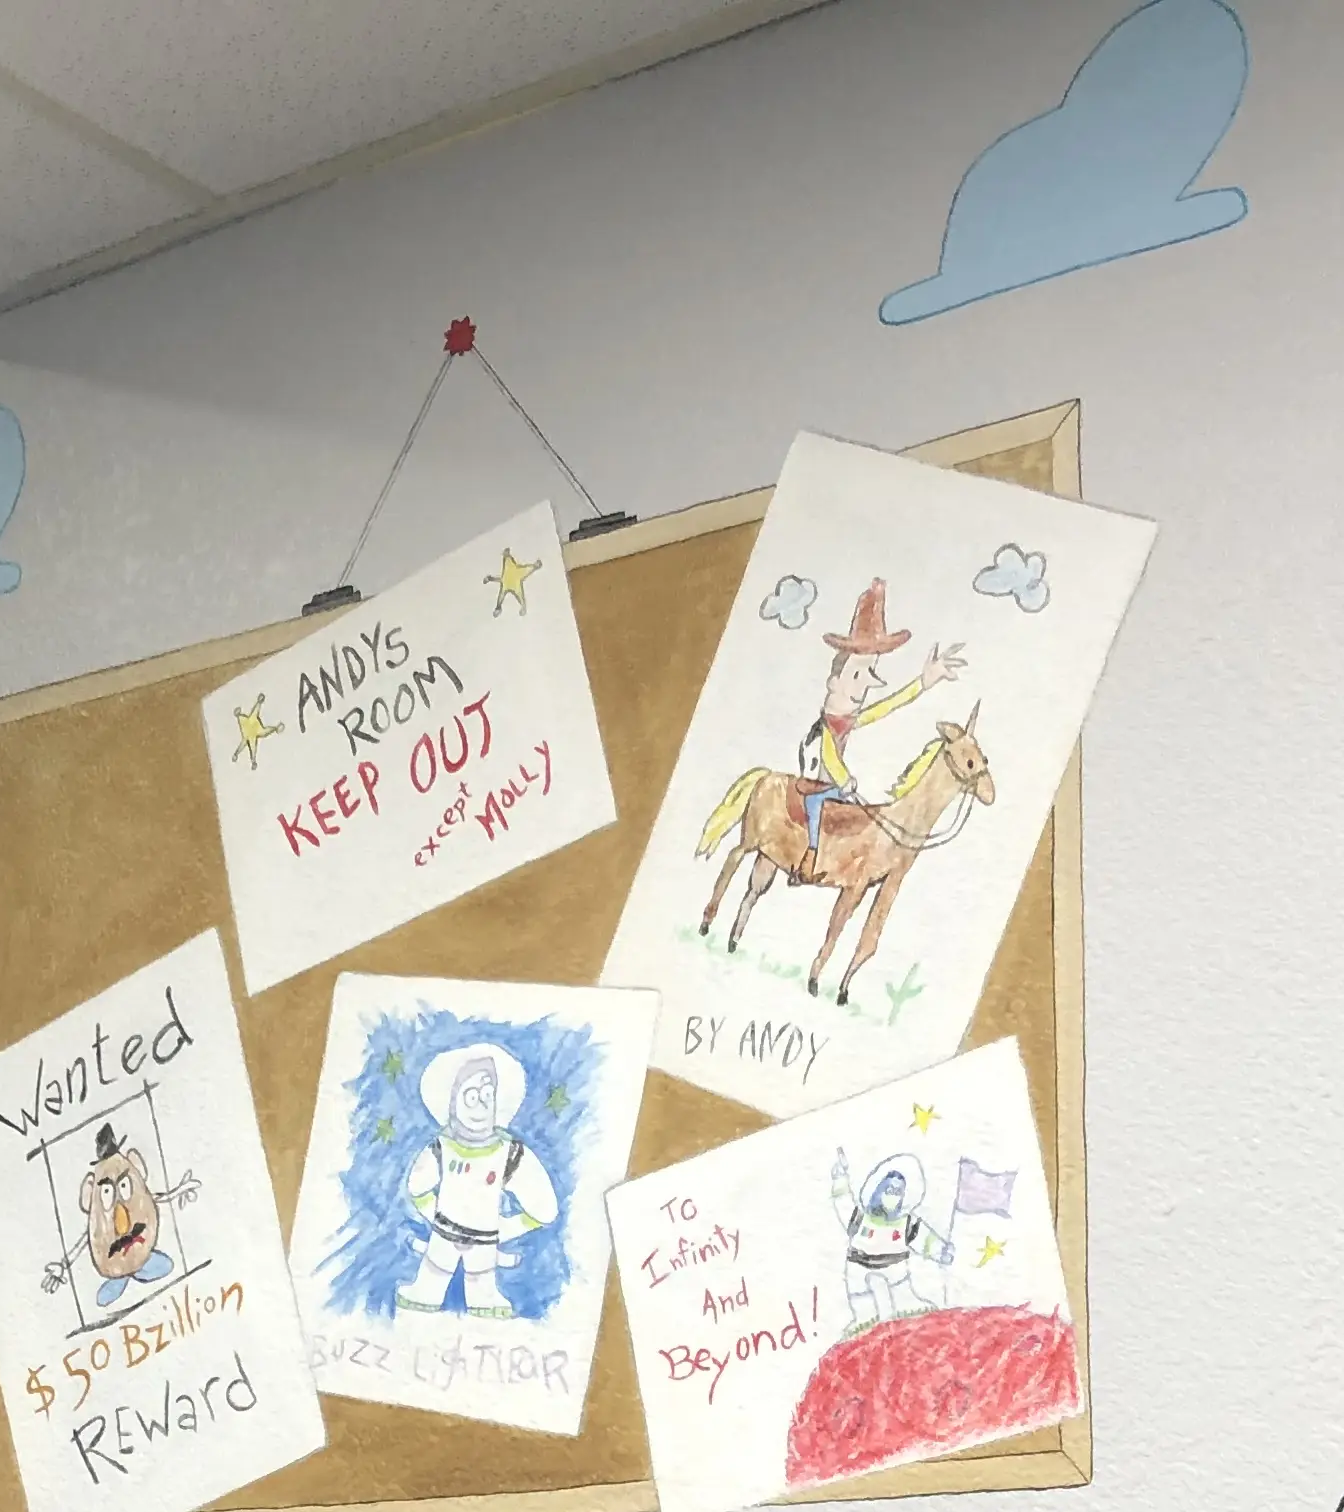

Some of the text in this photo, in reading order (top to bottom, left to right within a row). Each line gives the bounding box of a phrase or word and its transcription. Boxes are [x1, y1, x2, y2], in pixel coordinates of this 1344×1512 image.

[296, 621, 410, 733] ANDYS
[337, 655, 464, 756] ROOM
[276, 690, 492, 857] KEEP OUT
[414, 781, 472, 867] except
[683, 1015, 830, 1085] BY ANDY
[641, 1223, 742, 1290] Infinity
[701, 1277, 749, 1325] And
[124, 1281, 245, 1370] Bzillion
[657, 1286, 819, 1406] Beyond!
